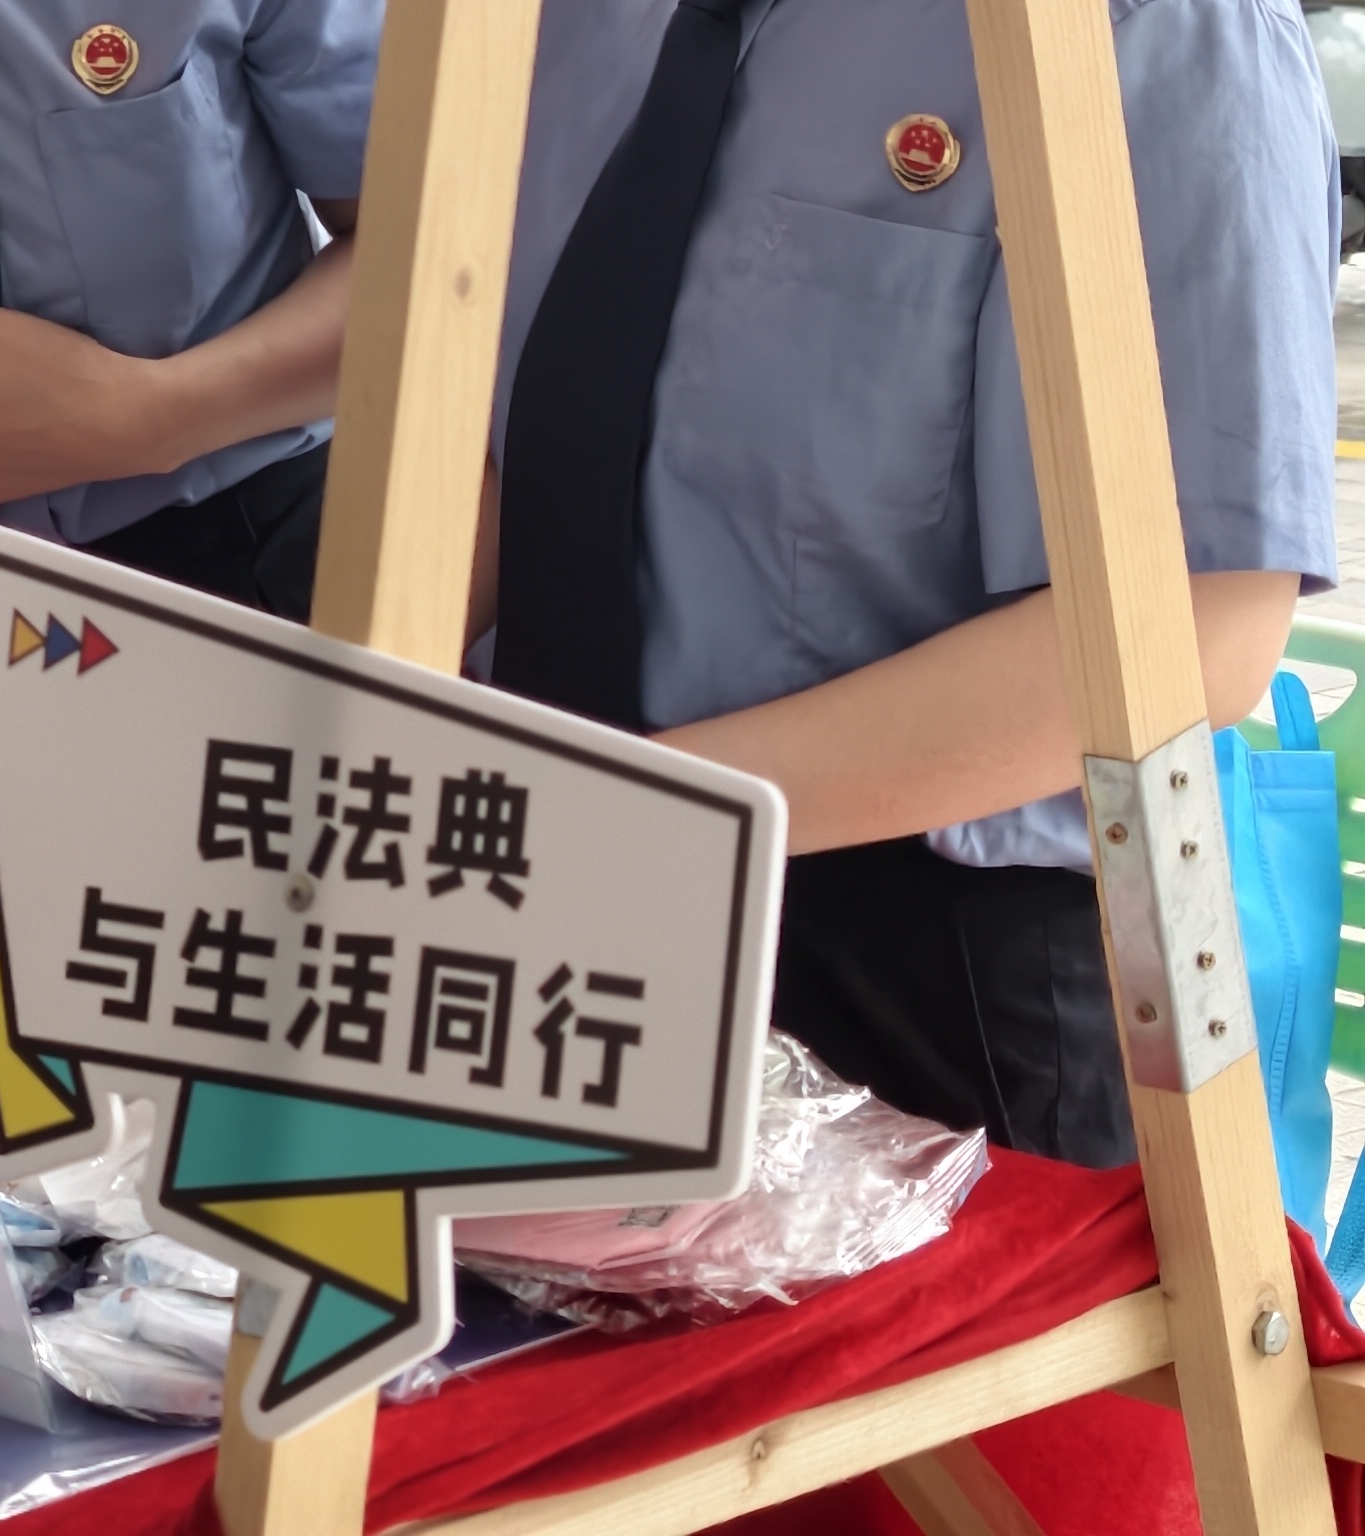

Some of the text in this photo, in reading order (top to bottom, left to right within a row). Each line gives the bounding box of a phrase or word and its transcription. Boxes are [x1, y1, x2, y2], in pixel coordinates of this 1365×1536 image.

[196, 737, 531, 912] 民法典
[65, 885, 646, 1109] 与生活同行
